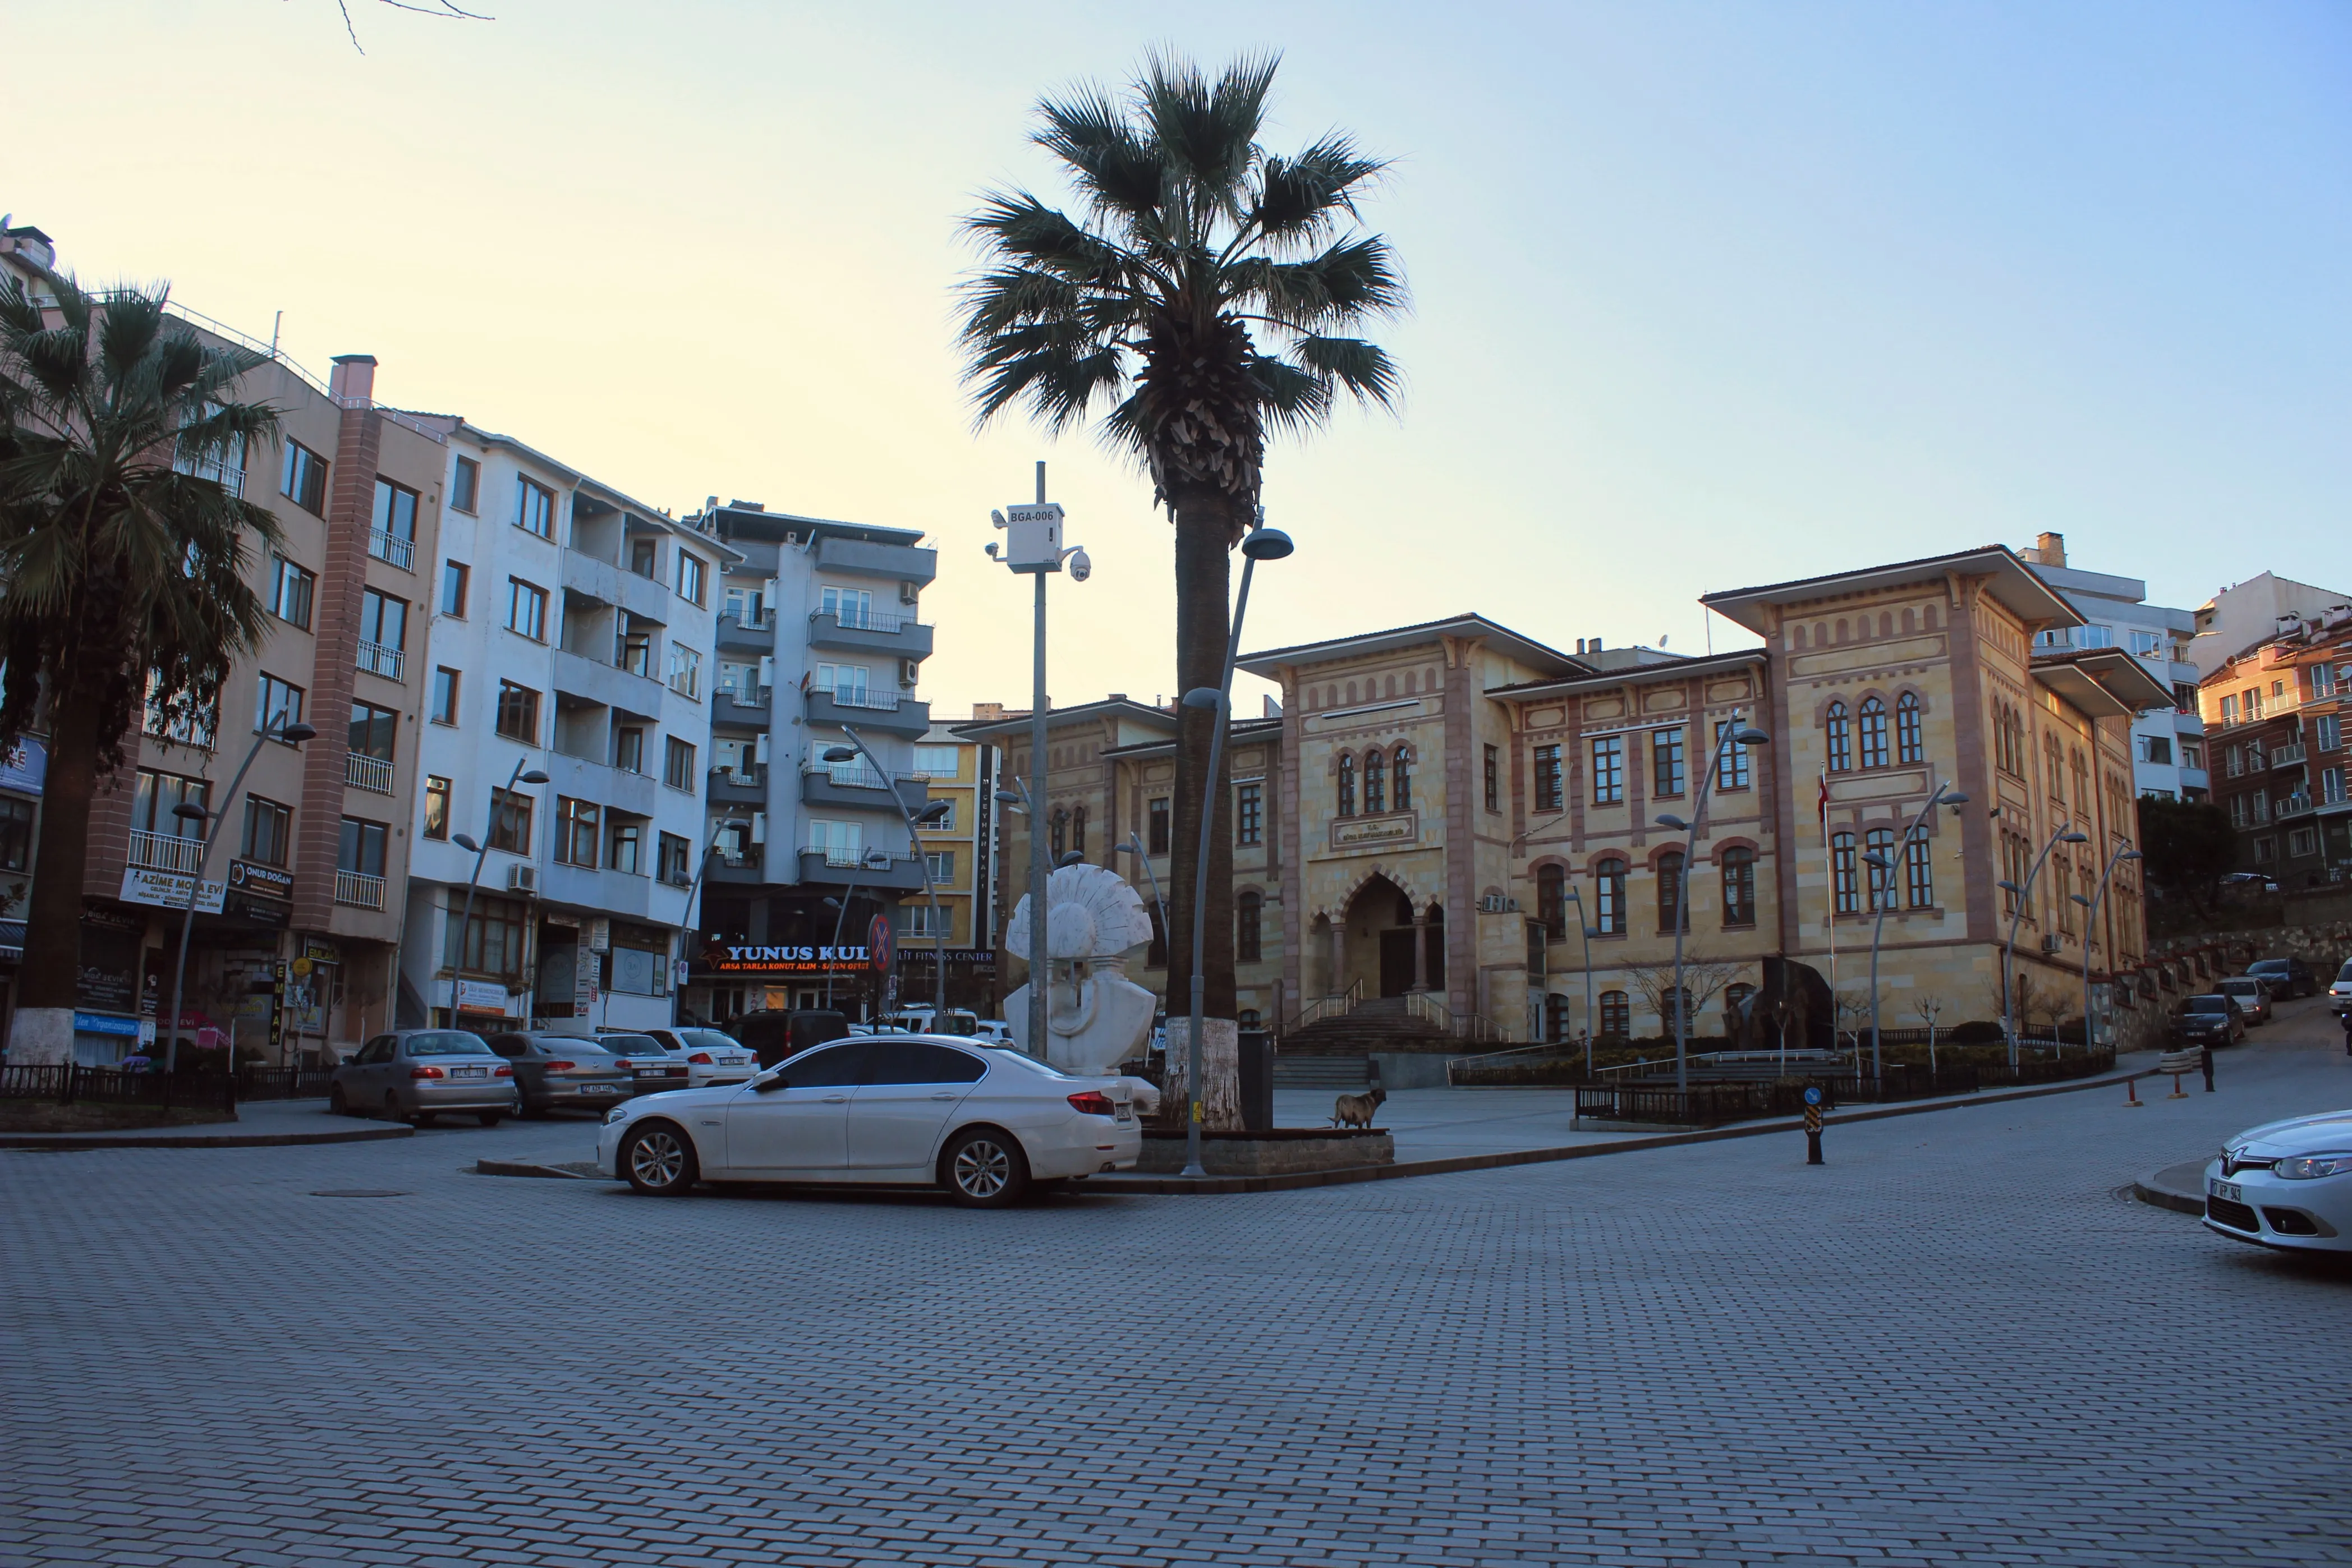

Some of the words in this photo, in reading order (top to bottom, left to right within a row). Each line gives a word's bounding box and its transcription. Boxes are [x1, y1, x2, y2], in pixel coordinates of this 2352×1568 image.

[1011, 511, 1053, 522] BGA-006
[247, 866, 267, 879] ONUR
[267, 872, 291, 885] DOĞAN
[141, 873, 174, 888] AZİME
[176, 879, 205, 893] MOA
[208, 883, 224, 895] EVİ
[309, 948, 334, 962] EMLAK
[728, 946, 813, 960] YUNUS
[819, 946, 870, 960] KUL
[956, 952, 993, 961] CENTER
[272, 967, 284, 1043] EMLAK
[2231, 1187, 2241, 1201] 943
